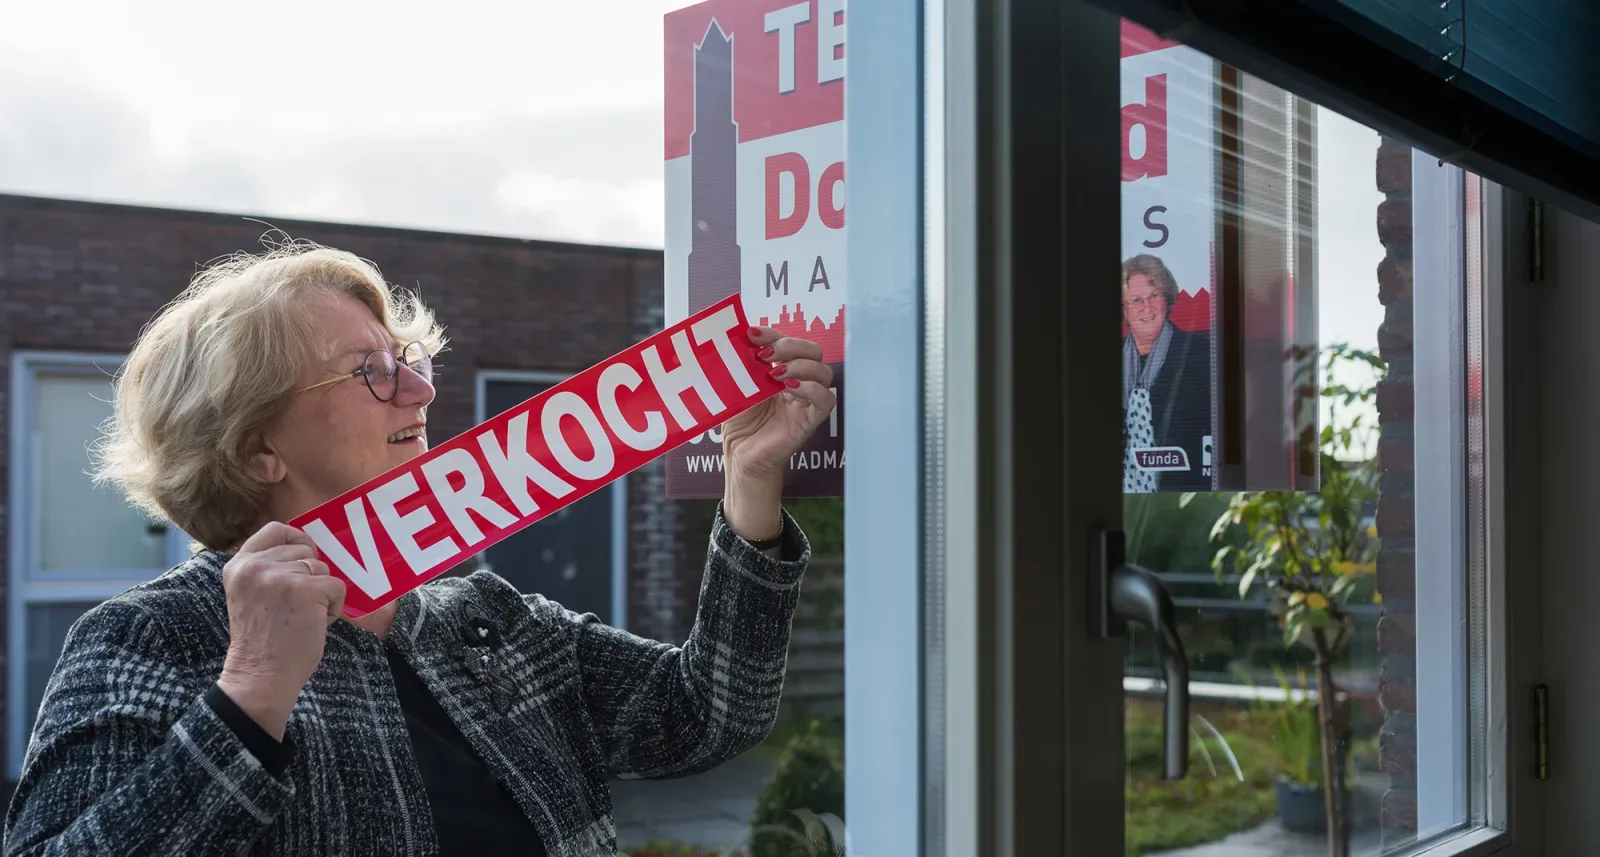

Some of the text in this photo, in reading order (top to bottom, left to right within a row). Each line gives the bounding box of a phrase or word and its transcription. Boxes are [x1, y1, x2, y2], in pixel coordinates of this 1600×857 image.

[1142, 205, 1170, 249] S
[765, 255, 831, 298] MA
[301, 304, 761, 601] VERKOCHT
[1141, 452, 1179, 465] funda
